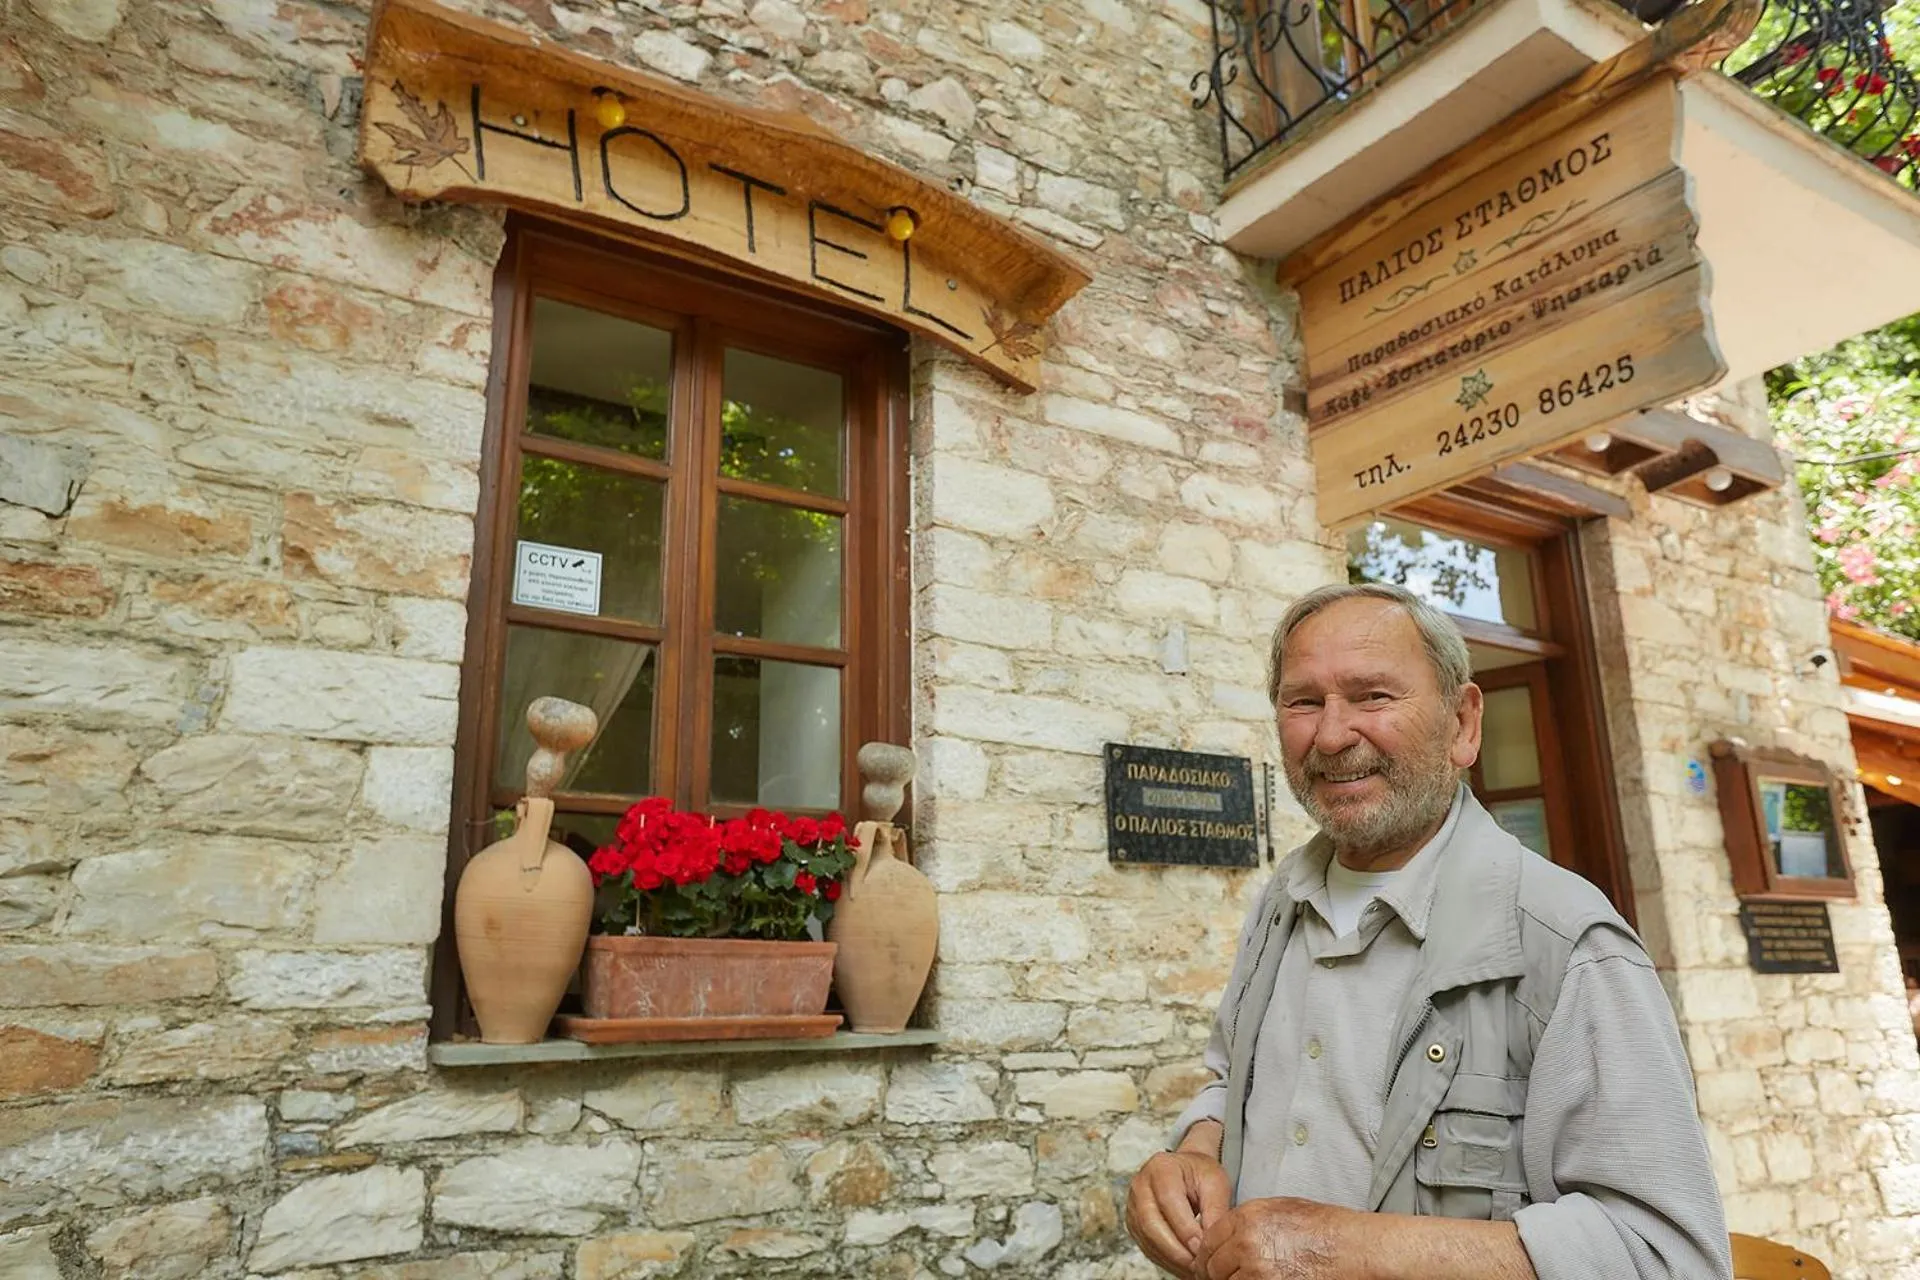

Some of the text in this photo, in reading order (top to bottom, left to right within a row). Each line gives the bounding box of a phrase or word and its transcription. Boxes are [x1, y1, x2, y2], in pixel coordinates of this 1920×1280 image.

[470, 83, 974, 342] HOTEL
[1337, 131, 1613, 305] ΠΑΛΙΟΣ ΣΤΑΘΜΟΣ
[1346, 228, 1620, 373] Παραδοσιακό Κατάλυμα
[1531, 244, 1664, 319] Ψησταριά
[1353, 353, 1635, 489] τηλ. 24230 86425
[528, 551, 568, 568] CCTV
[1115, 815, 1256, 841] Ο ΠΑΛΙΟΣ ΣΤΑΘΜΟΣ
[1127, 763, 1231, 788] ΠΑΡΑΔΟΣΙΑΚΟ
